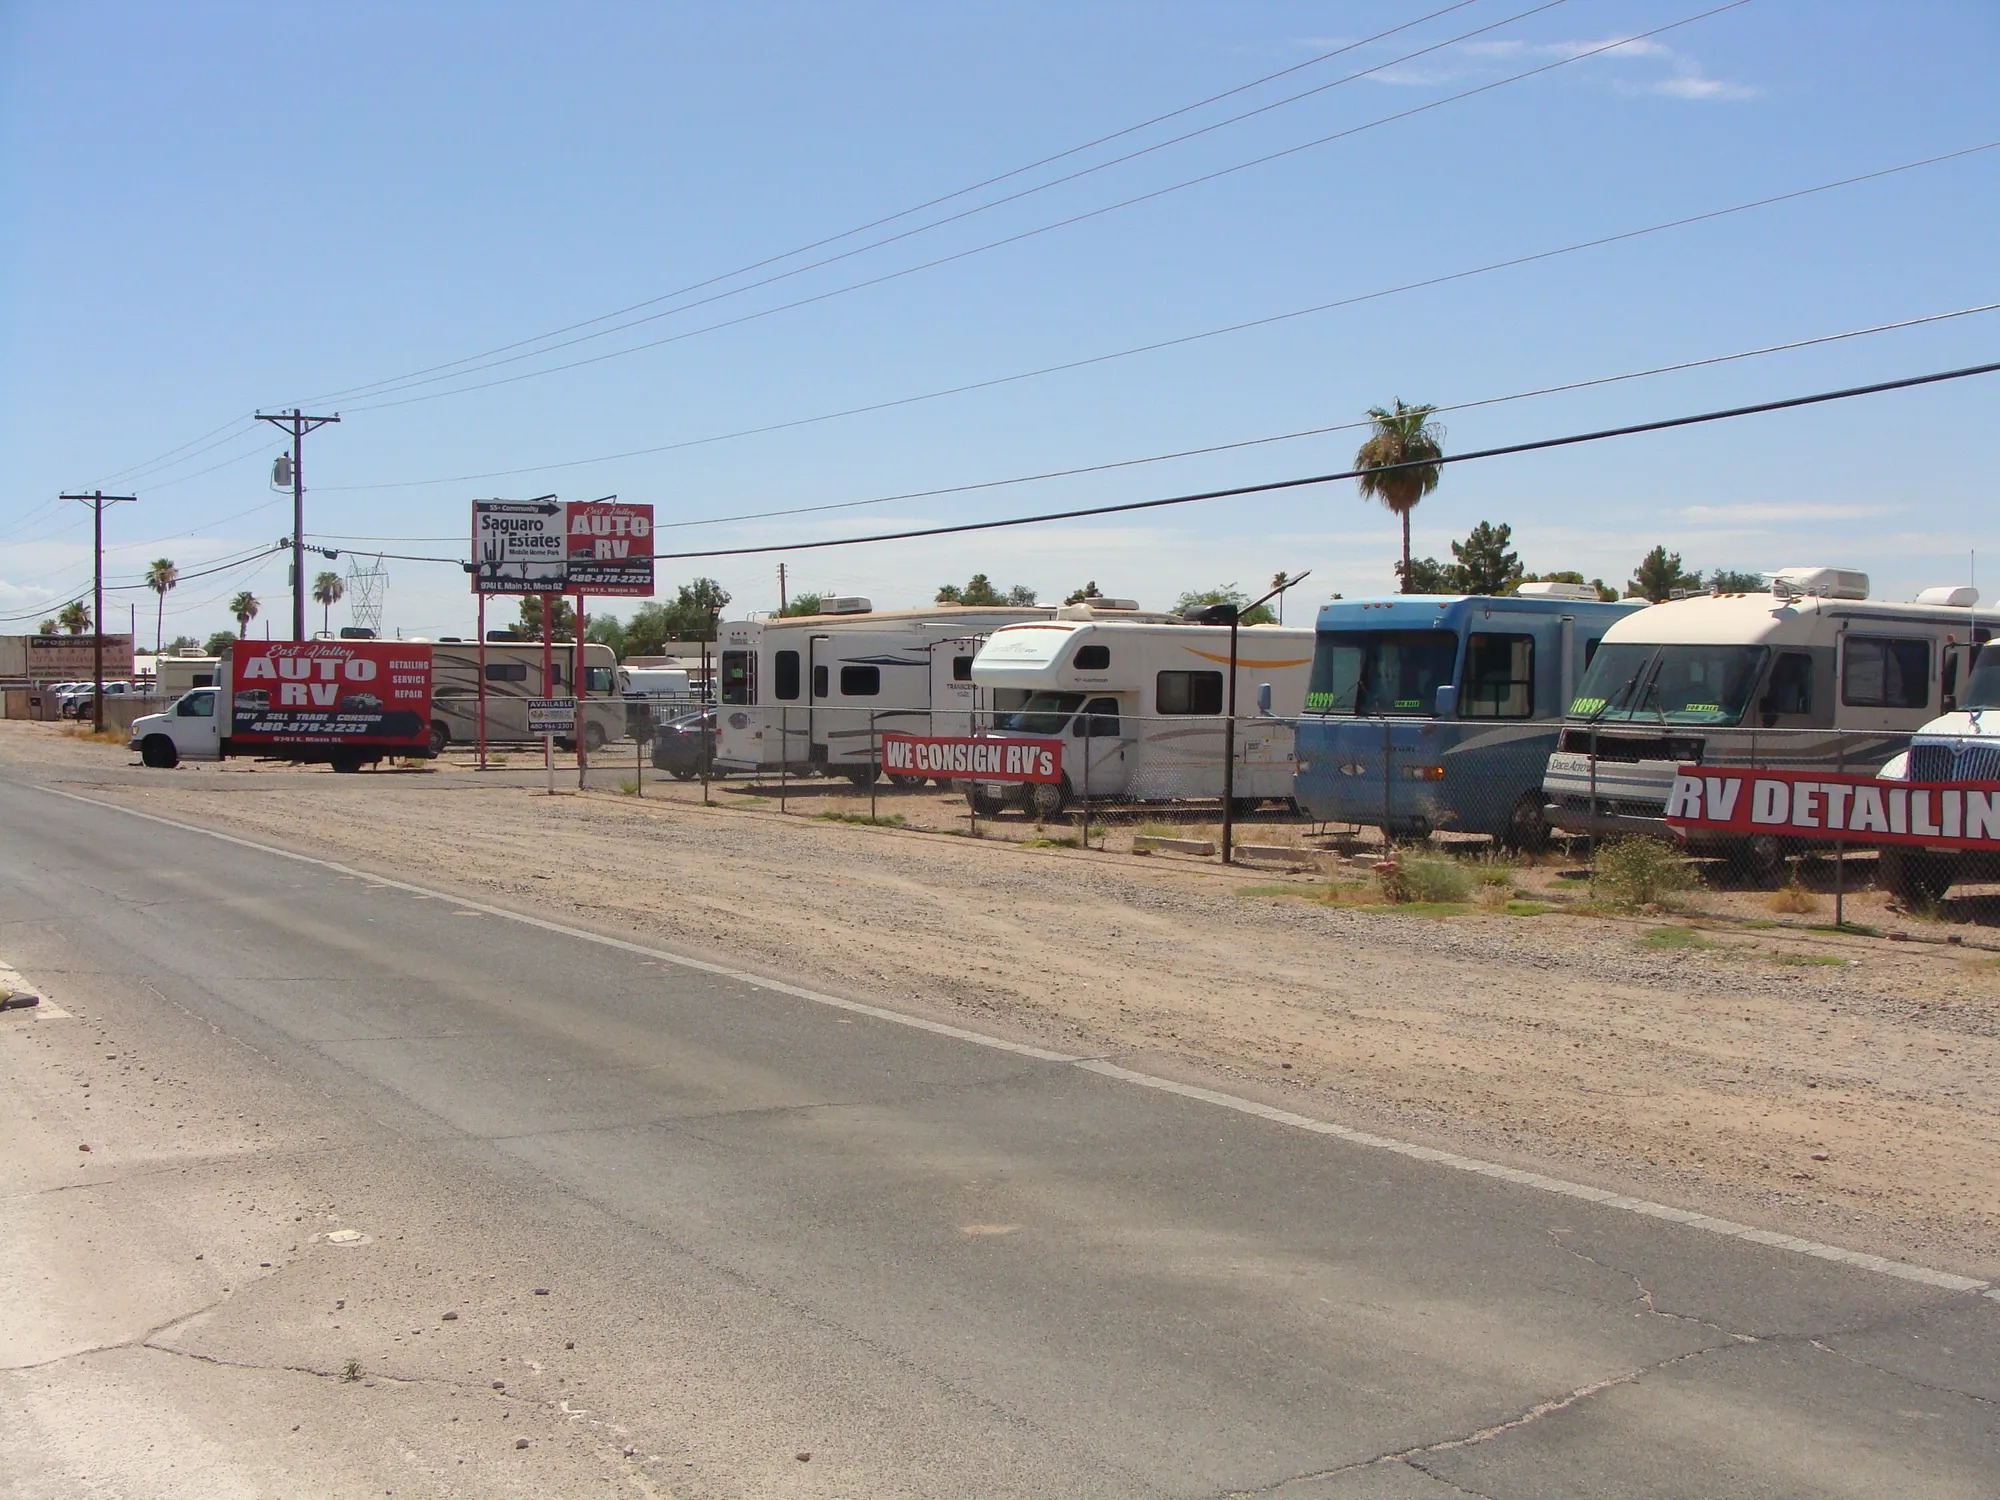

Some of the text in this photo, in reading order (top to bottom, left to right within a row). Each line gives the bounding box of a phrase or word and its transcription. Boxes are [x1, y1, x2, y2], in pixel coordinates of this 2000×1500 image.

[502, 505, 539, 513] Community
[482, 514, 544, 534] Saguaro
[571, 514, 649, 537] AUTO
[508, 532, 560, 548] Estates
[595, 539, 630, 560] RV
[569, 574, 651, 584] 480-878-2233
[498, 582, 503, 590] E.
[504, 582, 522, 590] Main
[266, 644, 355, 662] East Valley
[243, 657, 377, 681] AUTO
[390, 661, 429, 669] DETAILING
[392, 675, 425, 684] SERVICE
[281, 682, 340, 706] RV
[395, 690, 422, 698] REPAIR
[236, 712, 258, 720] BUY
[250, 722, 368, 732] 480-878-2233
[887, 741, 1053, 776] WE CONSIGN RV's
[1551, 759, 1569, 770] Pace
[1666, 775, 1742, 821] RV
